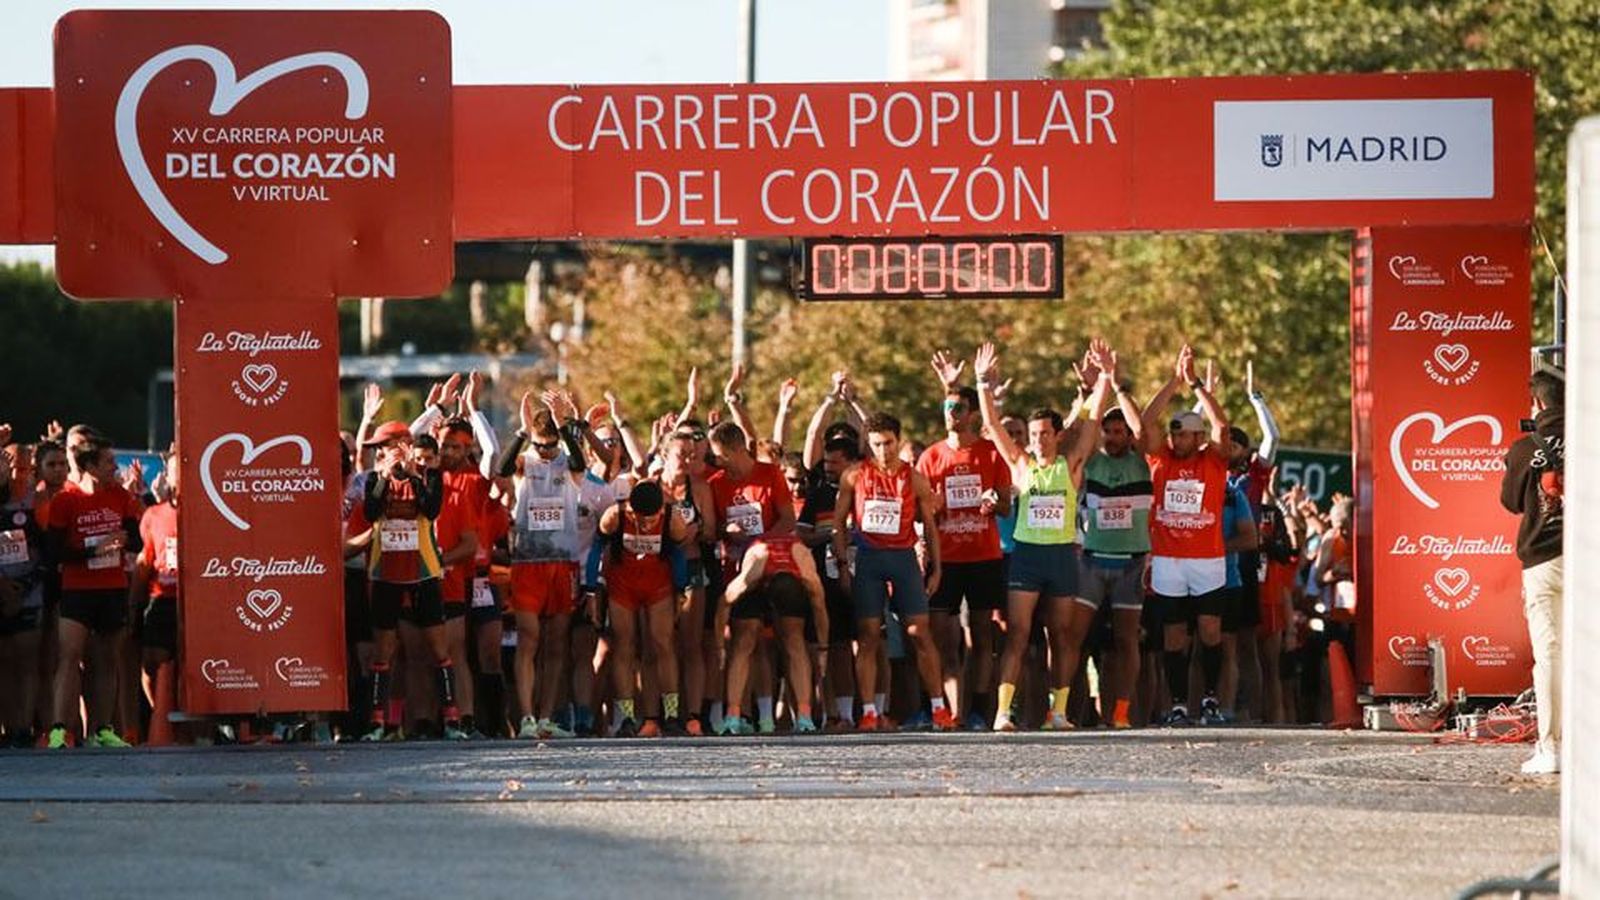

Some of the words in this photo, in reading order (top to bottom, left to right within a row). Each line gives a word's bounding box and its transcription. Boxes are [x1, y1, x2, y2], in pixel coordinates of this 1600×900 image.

[549, 94, 824, 150] CARRERA
[849, 90, 1117, 147] POPULAR
[173, 128, 198, 143] XV
[203, 128, 291, 143] CARRERA
[296, 128, 384, 143] POPULAR
[1306, 136, 1447, 162] MADRID
[166, 154, 226, 178] DEL
[233, 147, 395, 178] CORAZÓN
[233, 186, 246, 200] V
[250, 186, 329, 200] VIRTUAL
[636, 171, 738, 226] DEL
[761, 154, 1049, 224] CORAZÓN
[1389, 311, 1418, 330] La
[1419, 311, 1513, 336] Tagliatella
[196, 331, 226, 352] La
[226, 331, 321, 356] Tagliatella
[1429, 448, 1468, 456] CARRERA
[1412, 459, 1438, 471] DEL
[238, 469, 278, 480] CARRERA
[280, 469, 319, 479] POPULAR
[223, 481, 249, 492] DEL
[250, 475, 324, 492] CORAZÓN
[951, 488, 979, 499] 1819
[1170, 492, 1198, 504] 1039
[532, 511, 561, 522] 1838
[868, 514, 895, 525] 1177
[1033, 509, 1061, 520] 1924
[1103, 509, 1125, 521] 838
[389, 533, 410, 542] 211
[1390, 536, 1418, 555] La
[1419, 535, 1513, 560] Tagliatella
[201, 557, 230, 577] La
[230, 556, 327, 582] Tagliatella
